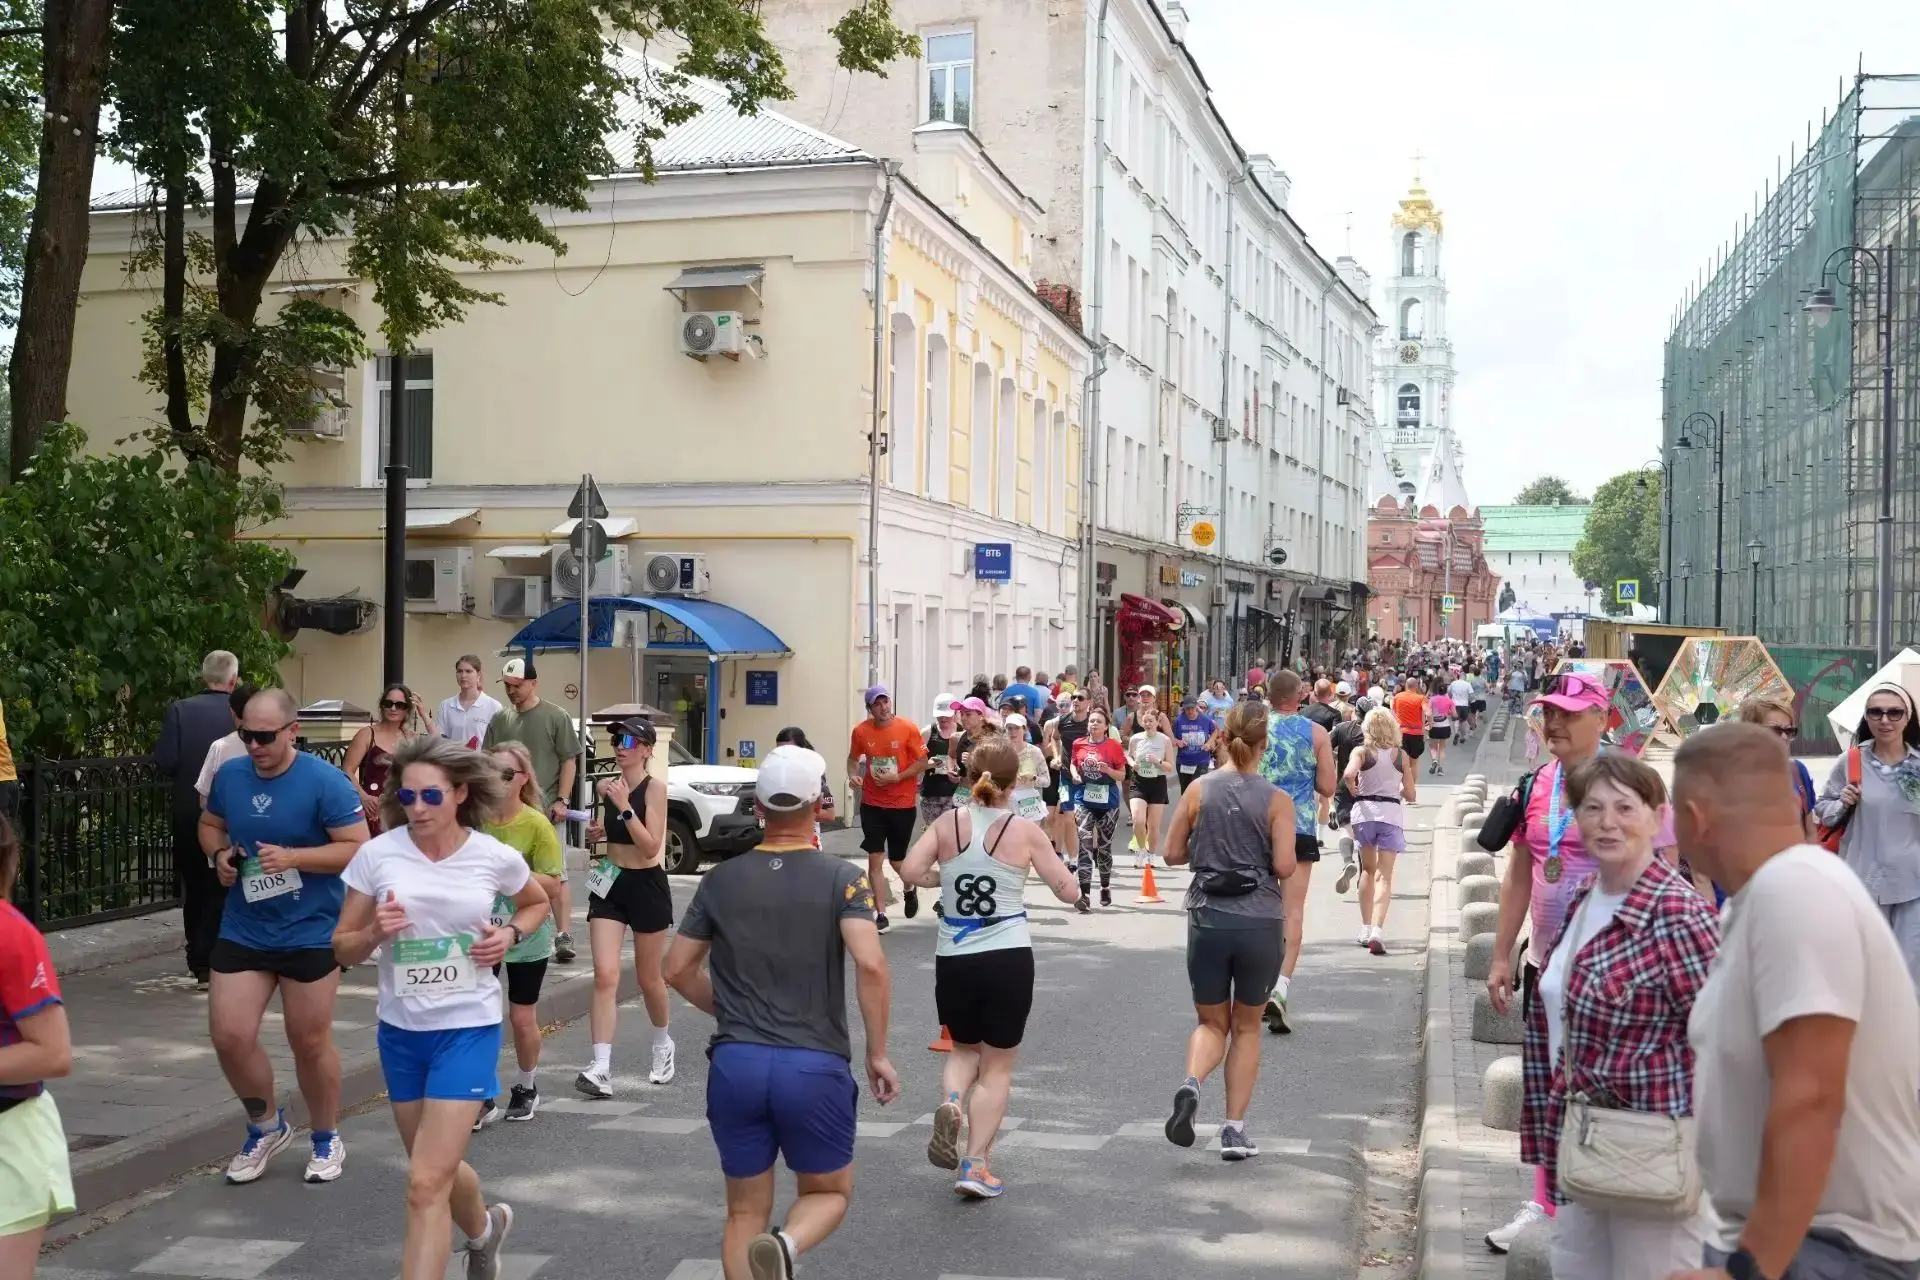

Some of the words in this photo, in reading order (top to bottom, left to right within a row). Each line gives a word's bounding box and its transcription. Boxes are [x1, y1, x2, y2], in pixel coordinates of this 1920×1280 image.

[985, 549, 1002, 557] ВТБ
[250, 874, 286, 893] 5108
[954, 873, 997, 896] GO
[955, 895, 997, 917] GO
[406, 965, 458, 985] 5220
